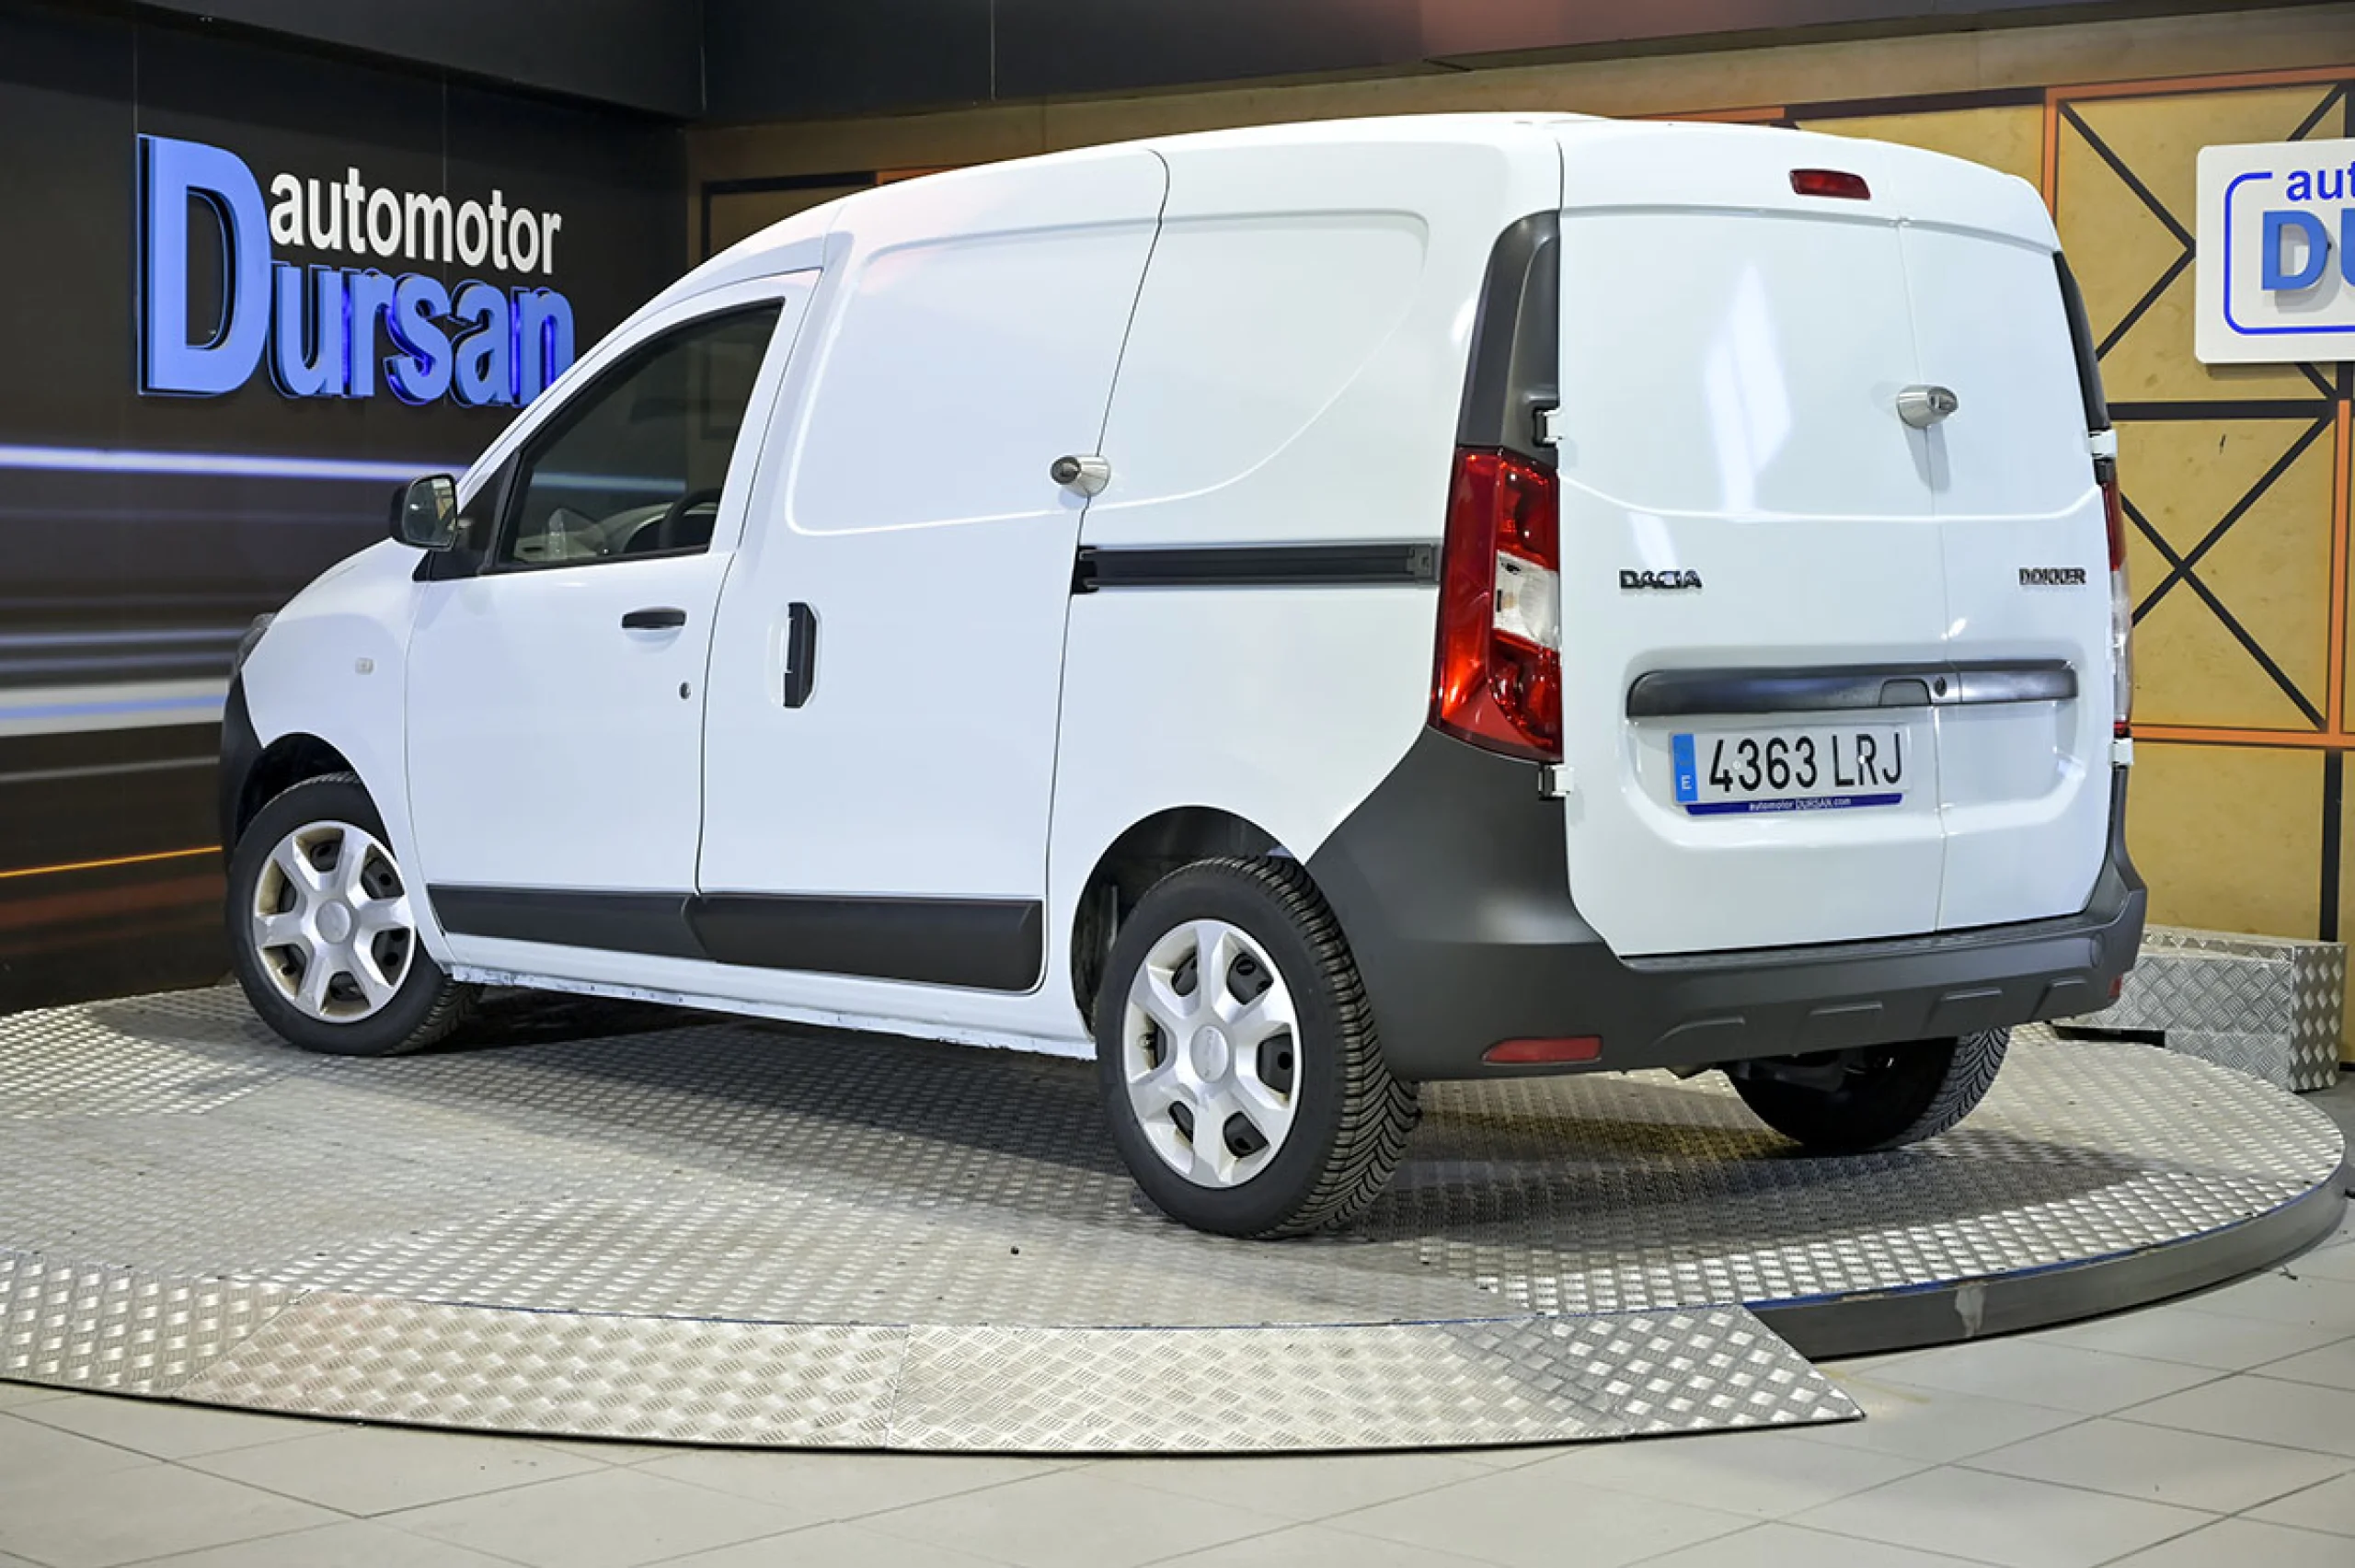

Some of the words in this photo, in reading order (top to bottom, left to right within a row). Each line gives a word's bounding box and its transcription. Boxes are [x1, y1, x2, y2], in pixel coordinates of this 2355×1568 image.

[270, 166, 561, 273] automotor
[137, 134, 575, 407] Dursan
[1619, 569, 1702, 589] DACIA
[2019, 567, 2086, 586] DOKKER
[1681, 775, 1691, 790] E
[1709, 737, 1818, 793] 4363
[1832, 731, 1901, 787] LRJ
